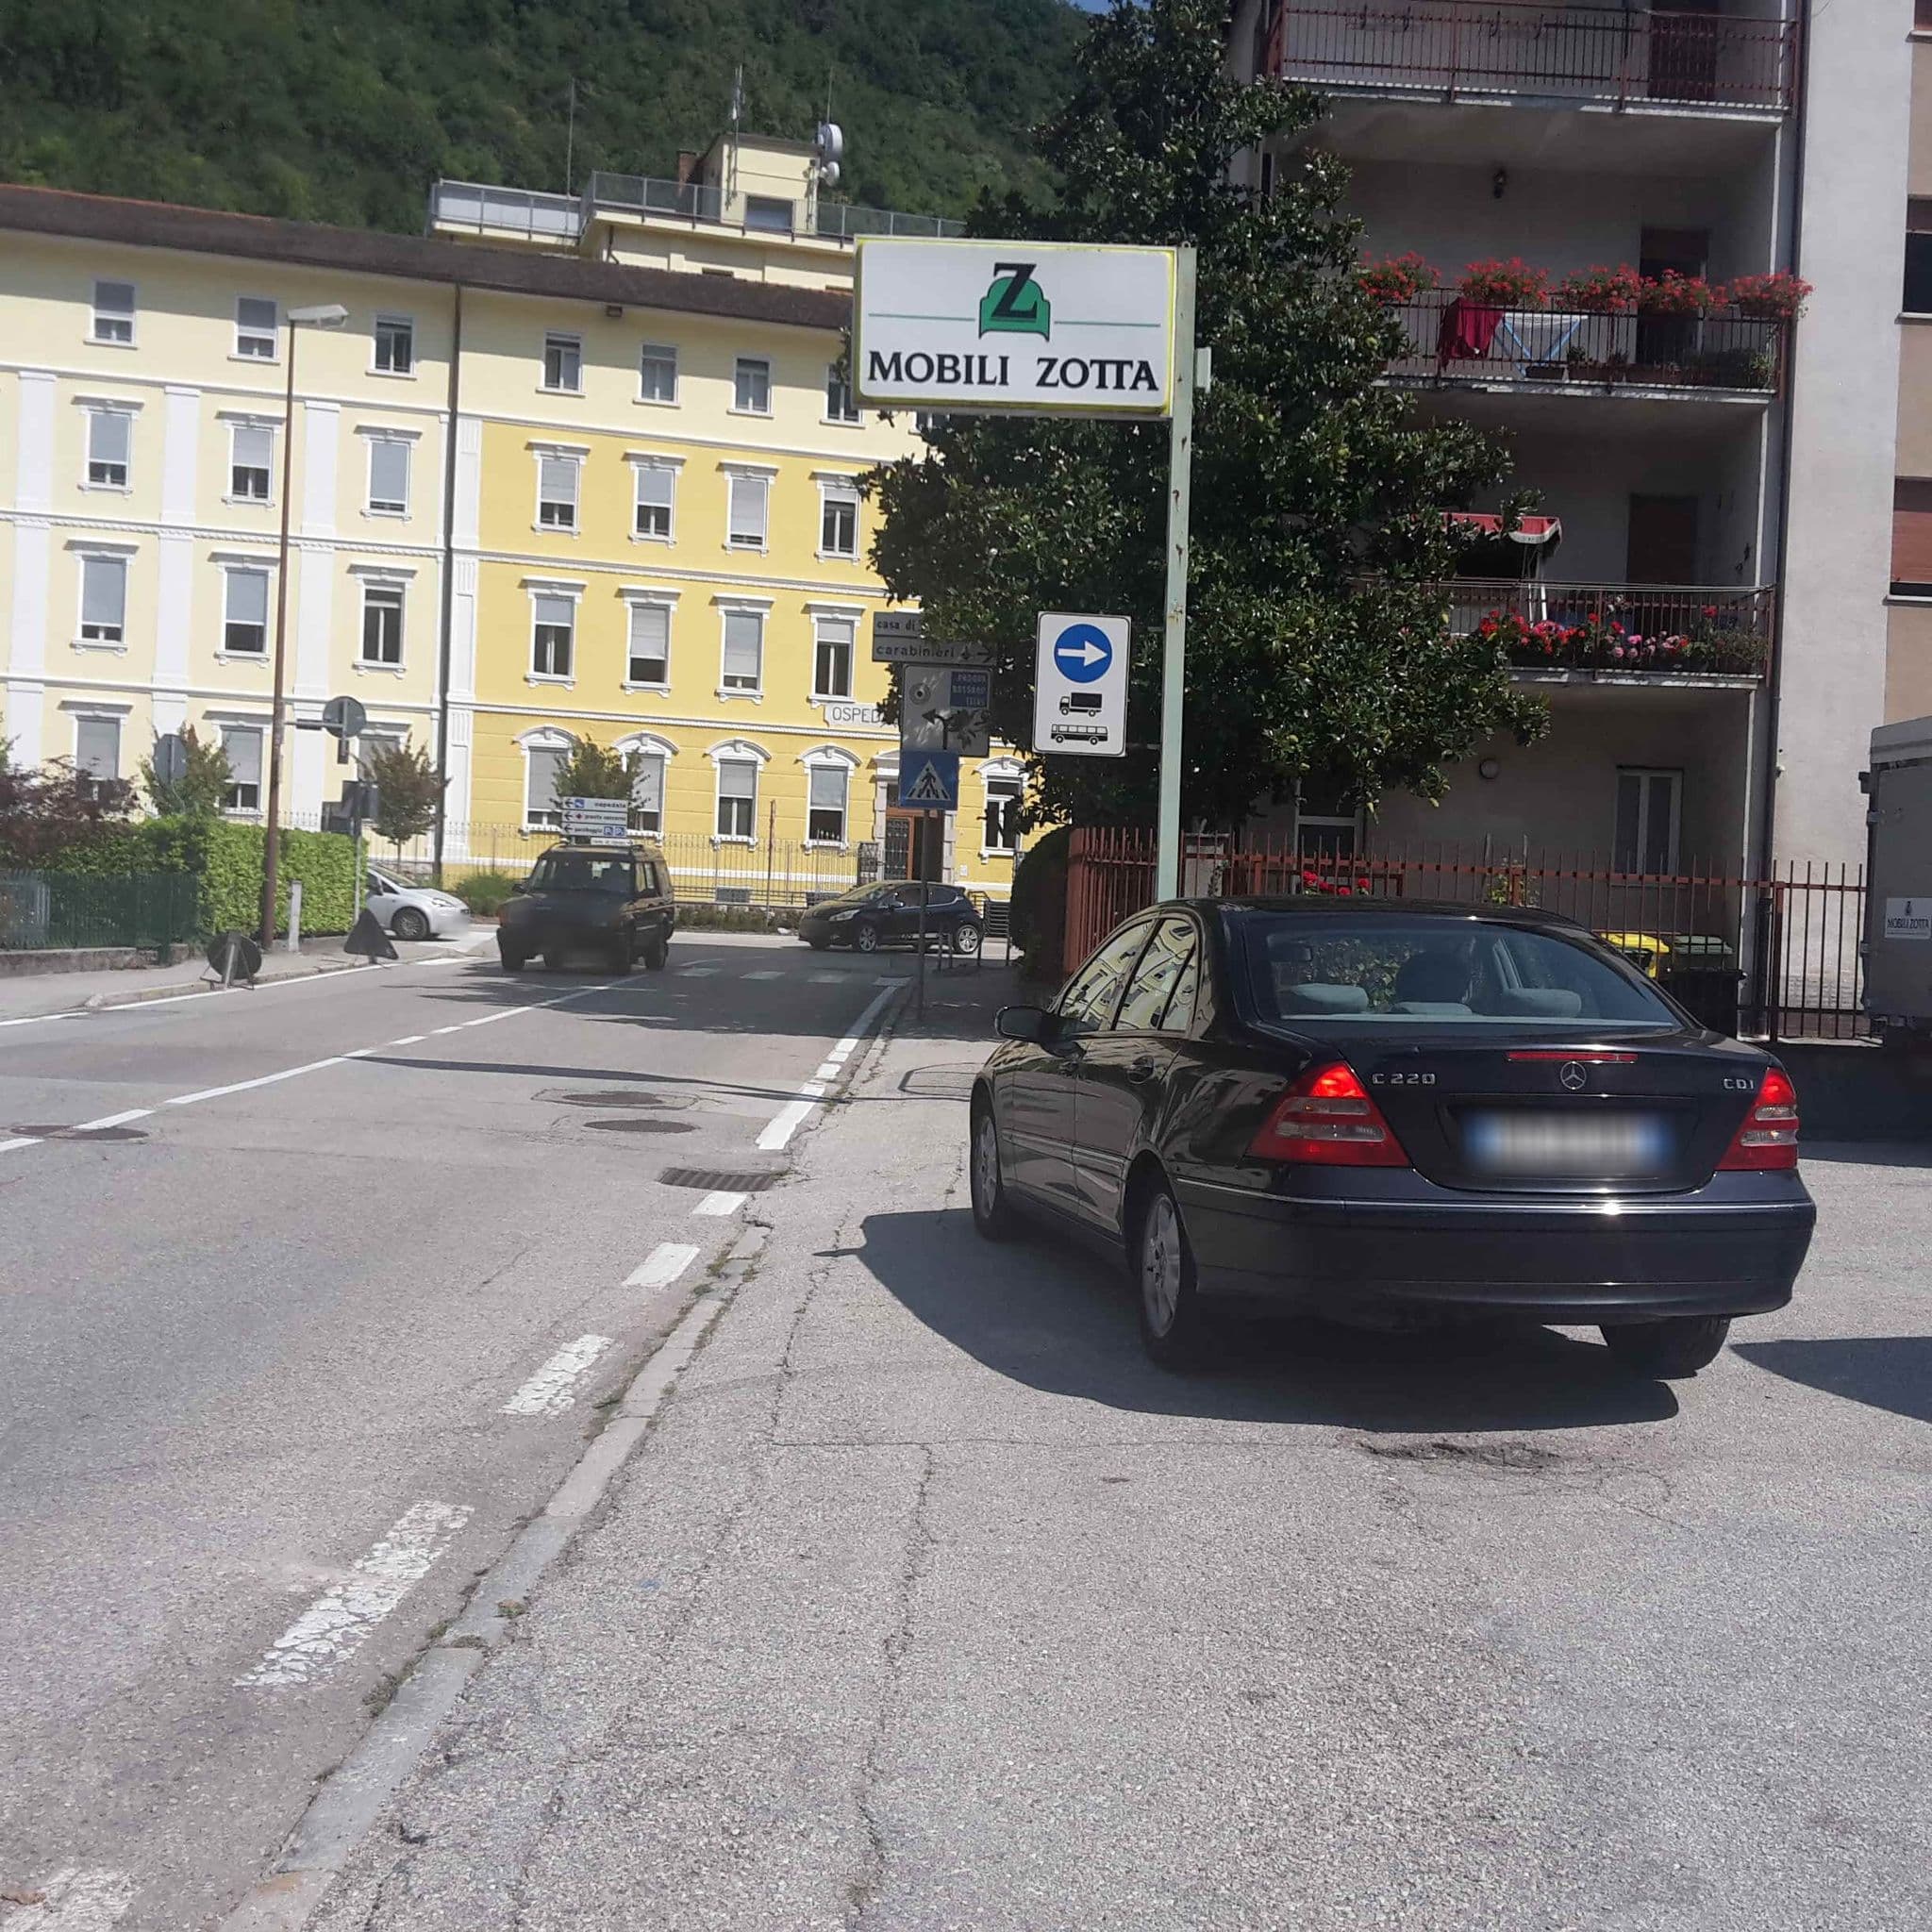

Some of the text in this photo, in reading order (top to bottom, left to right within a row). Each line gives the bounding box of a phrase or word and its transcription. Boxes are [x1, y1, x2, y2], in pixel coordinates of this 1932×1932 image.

[991, 262, 1037, 319] Z
[868, 350, 1158, 391] MOBILI ZOTTA
[876, 619, 915, 631] casa di
[832, 707, 882, 724] OSPED
[1887, 918, 1929, 929] MOBILI ZOTTA
[1373, 1074, 1435, 1085] C 220
[1724, 1078, 1754, 1090] CDI
